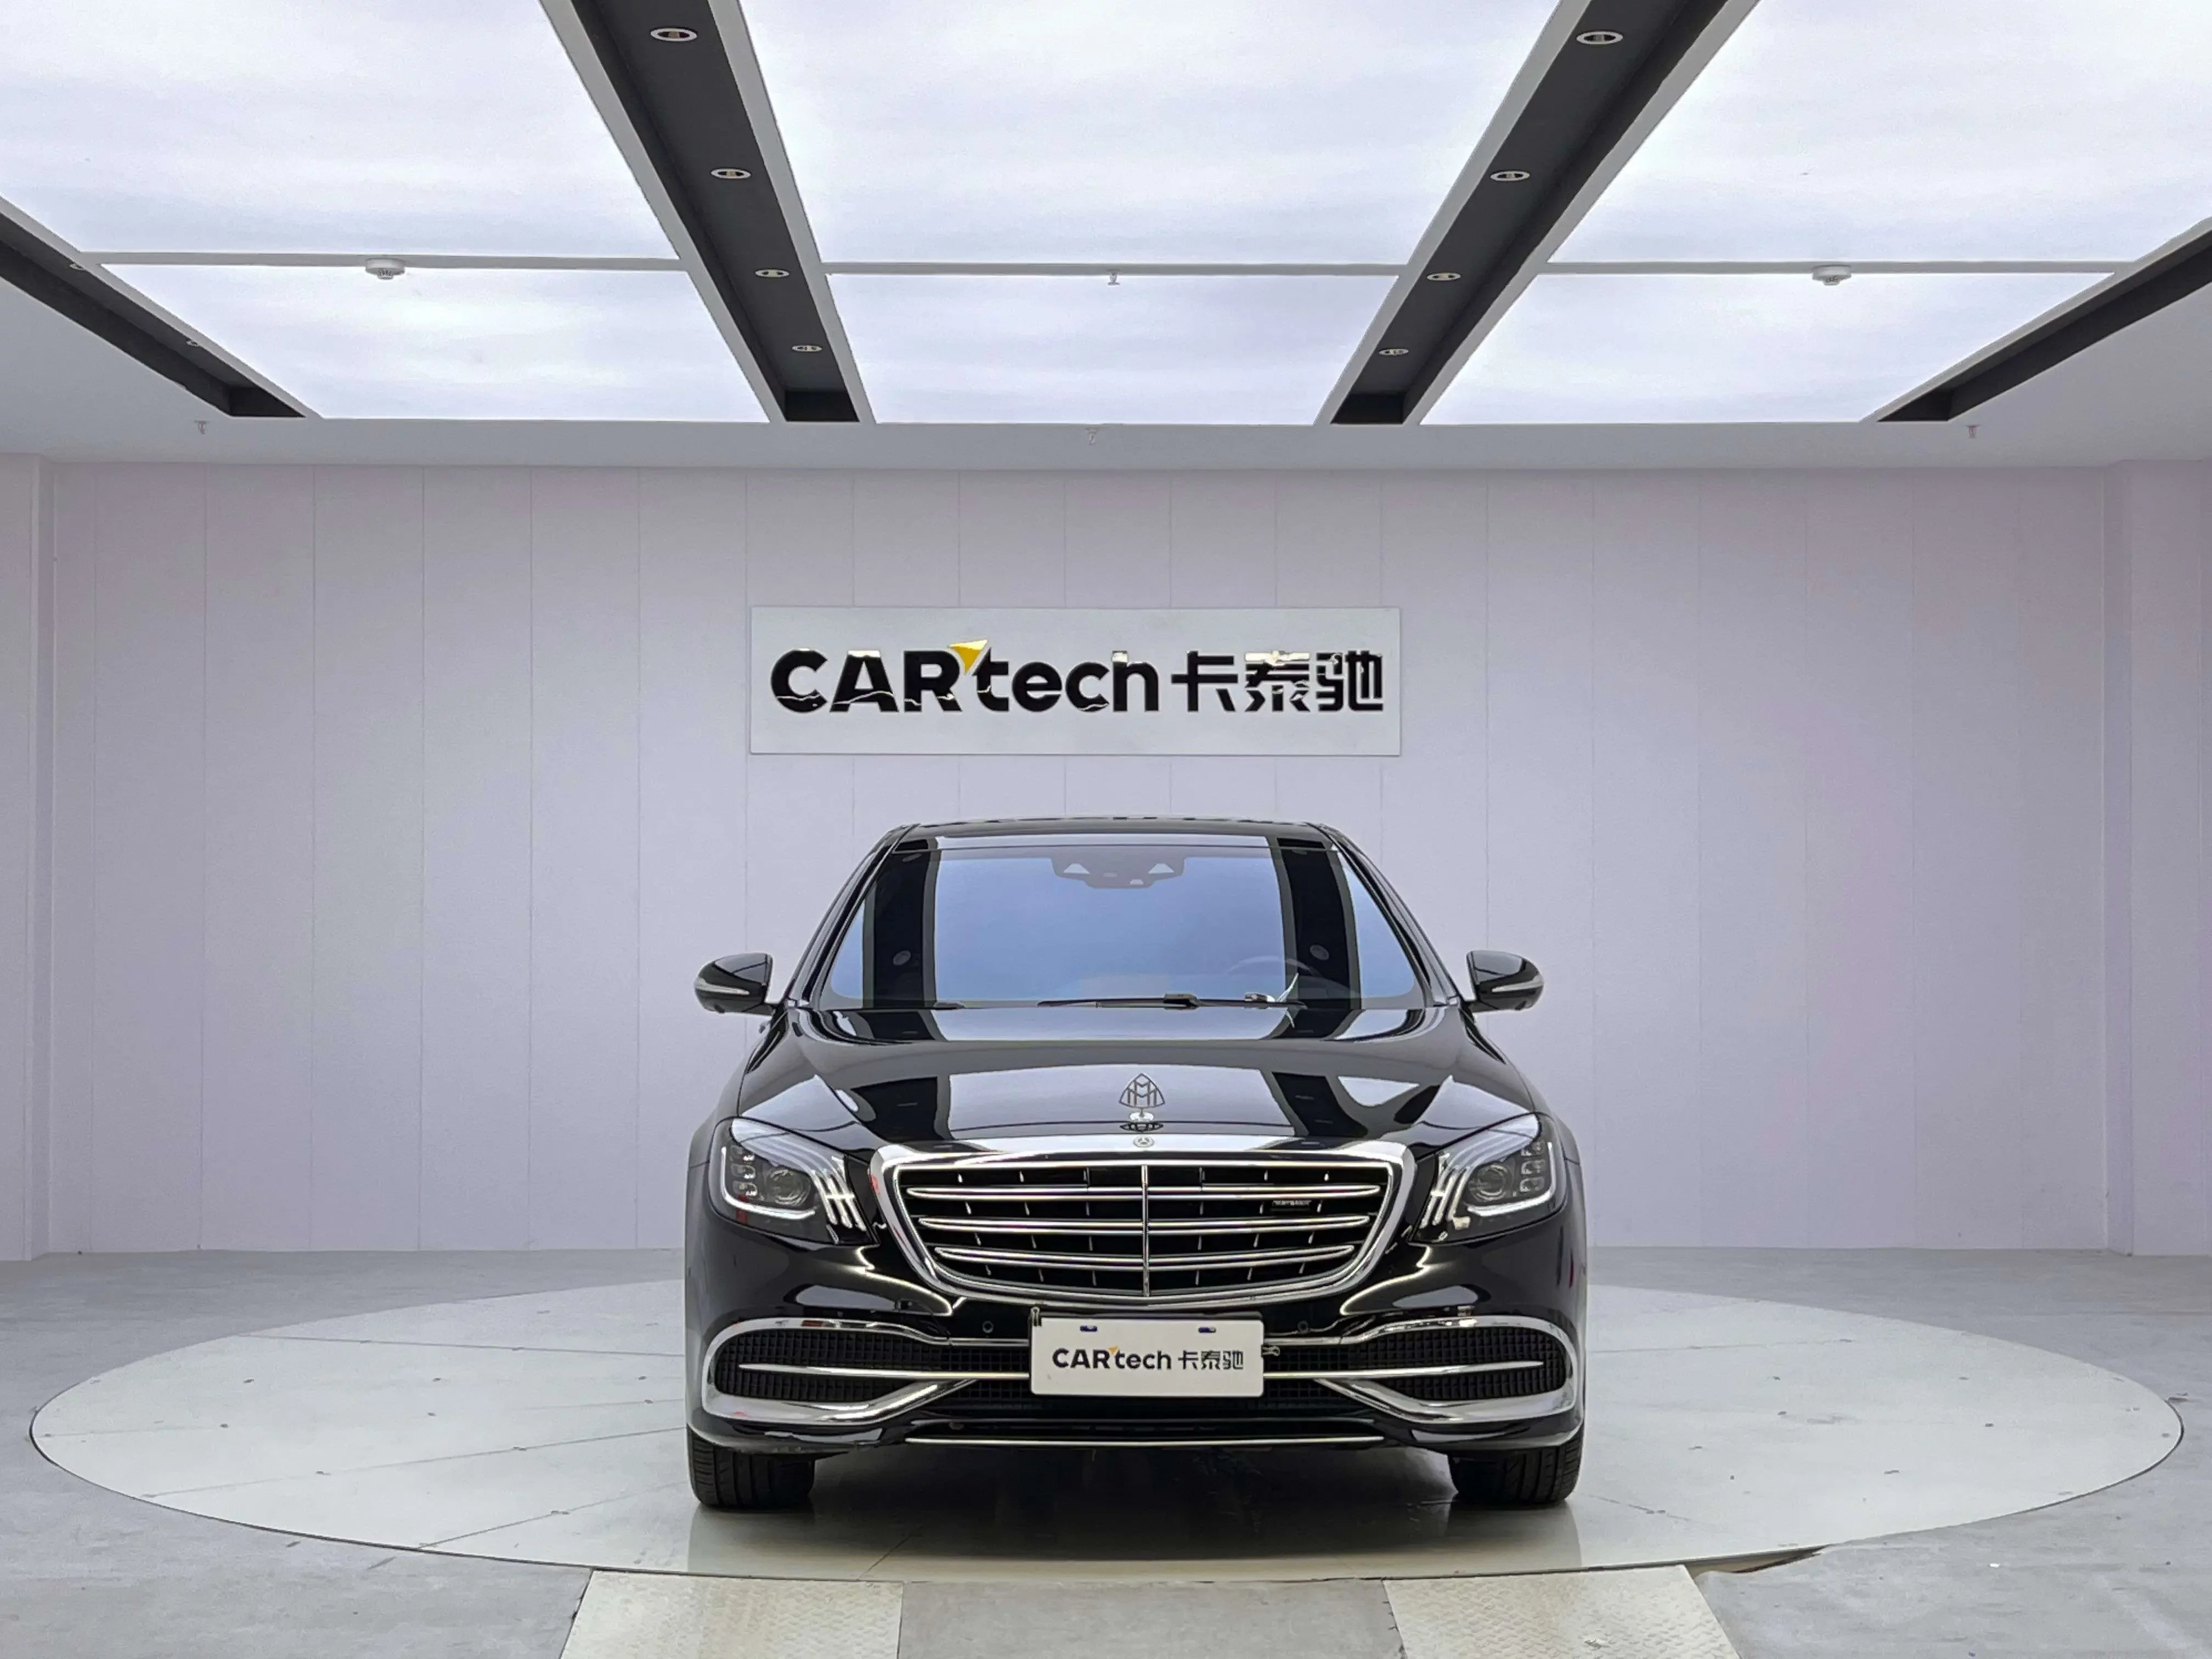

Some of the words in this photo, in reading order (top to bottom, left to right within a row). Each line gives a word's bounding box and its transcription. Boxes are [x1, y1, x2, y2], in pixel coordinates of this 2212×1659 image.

[1171, 650, 1384, 712] 卡泰驰
[1178, 1350, 1244, 1370] 卡泰驰
